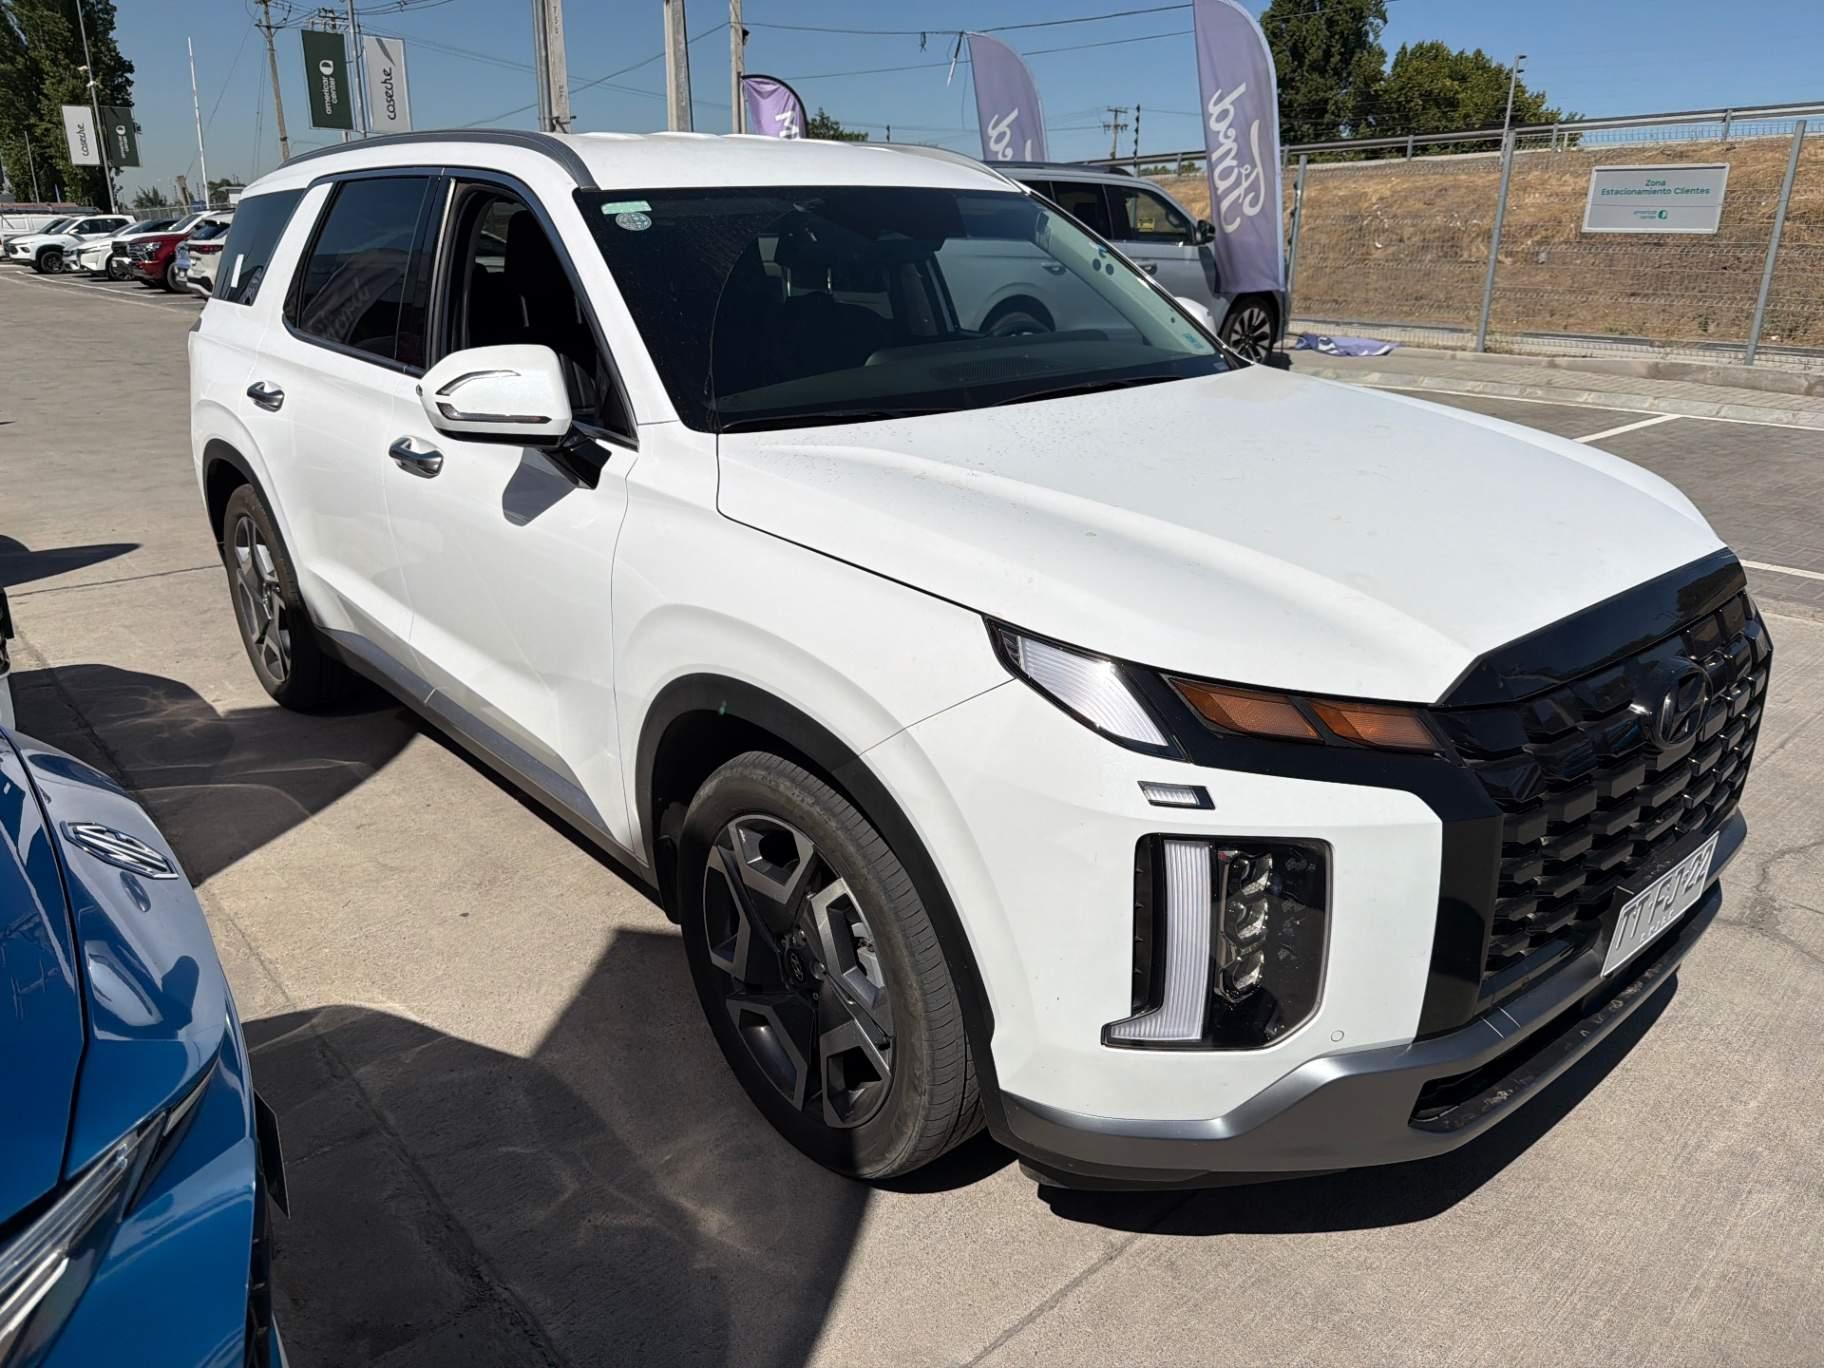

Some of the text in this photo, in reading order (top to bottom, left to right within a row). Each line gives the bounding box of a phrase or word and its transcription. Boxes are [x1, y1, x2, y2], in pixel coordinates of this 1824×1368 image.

[1645, 179, 1667, 187] Zona
[1600, 187, 1711, 196] Estacionamiento Clientes
